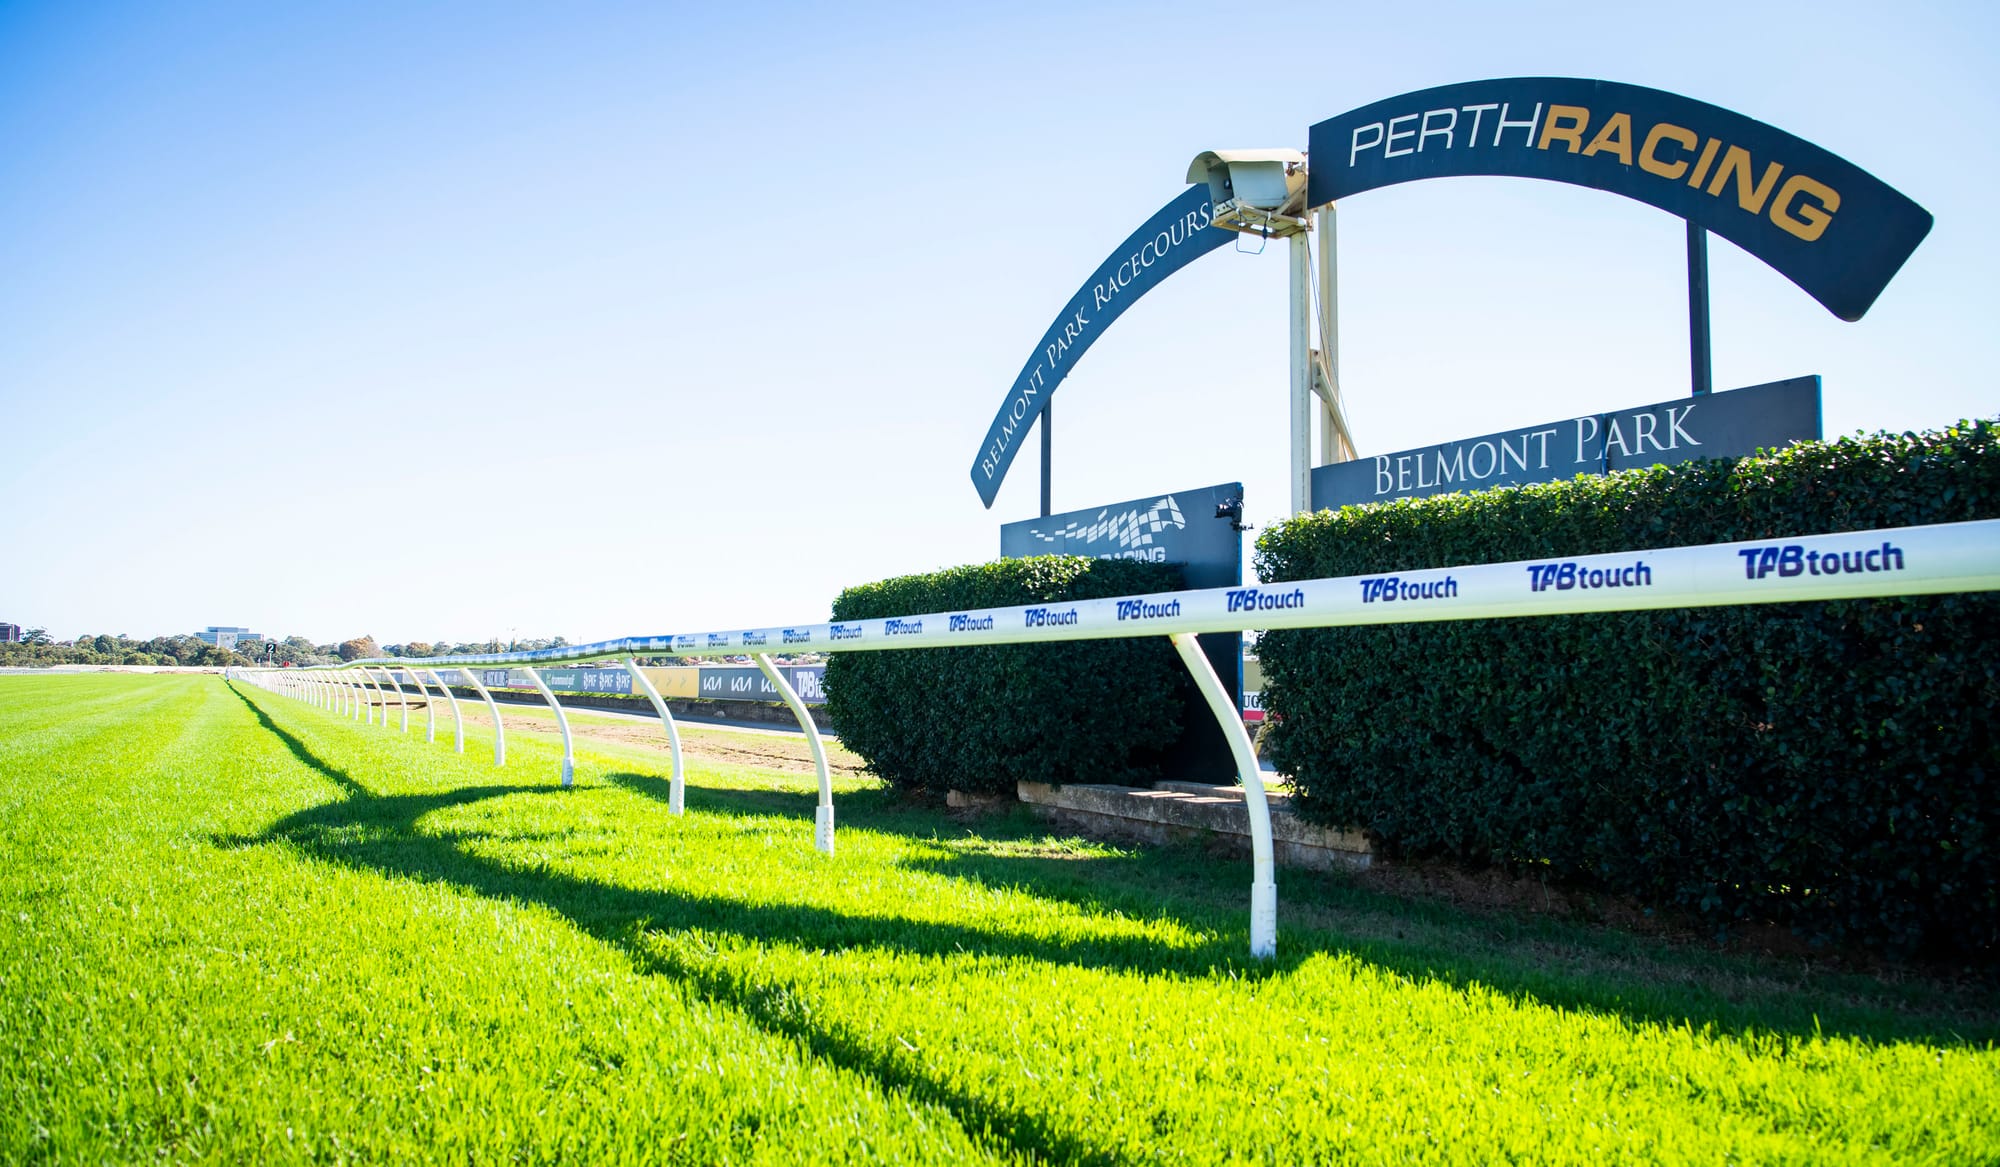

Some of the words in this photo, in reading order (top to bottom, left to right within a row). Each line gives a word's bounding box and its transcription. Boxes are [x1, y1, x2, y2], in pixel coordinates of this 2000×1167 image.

[982, 364, 1043, 480] BELMONT
[1046, 306, 1090, 369] PARK
[1092, 202, 1209, 311] RACECOURS
[1374, 429, 1557, 495] BELMONT
[1574, 405, 1702, 464] PARK
[783, 629, 810, 644] TABtouch
[829, 624, 862, 640] TABtouch
[884, 620, 922, 636] TABtouch
[949, 614, 993, 632] TABtouch
[1025, 608, 1078, 628] TABtouch
[1116, 599, 1180, 621] TABtouch
[1226, 588, 1304, 612] TABtouch
[1360, 576, 1457, 603] TABtouch
[1527, 561, 1652, 592] TABtouch
[1739, 542, 1904, 580] TABtouch
